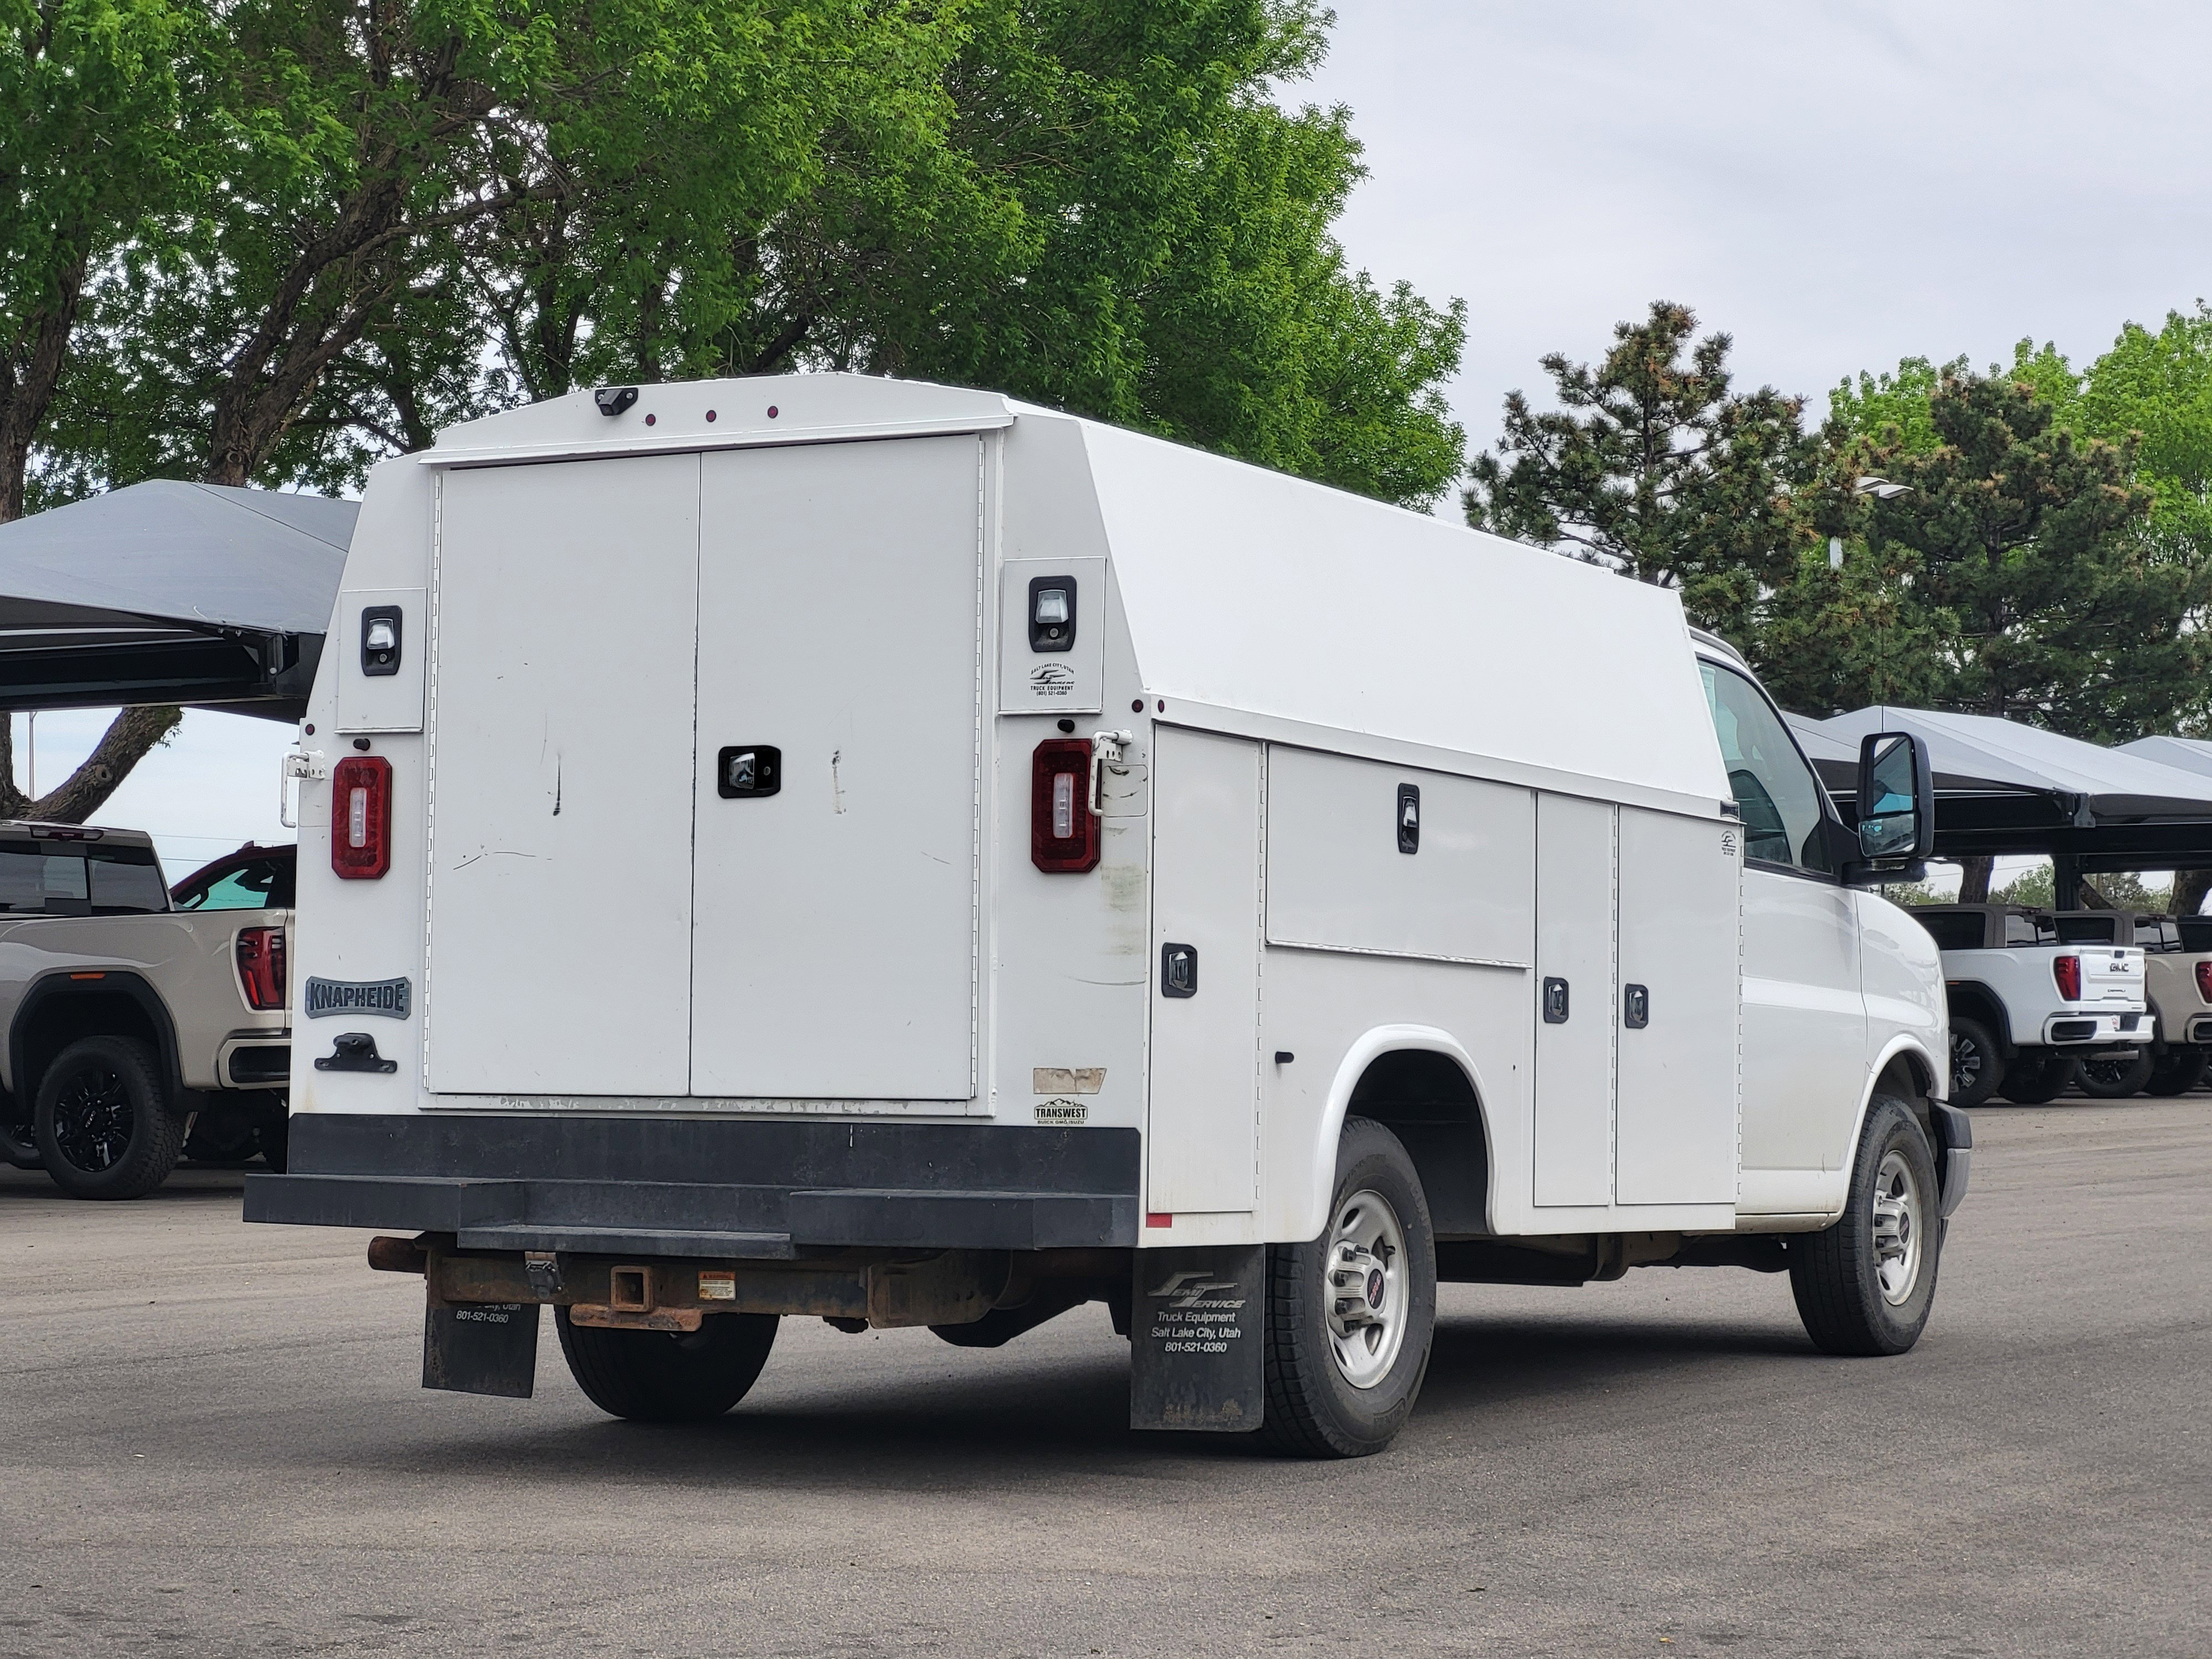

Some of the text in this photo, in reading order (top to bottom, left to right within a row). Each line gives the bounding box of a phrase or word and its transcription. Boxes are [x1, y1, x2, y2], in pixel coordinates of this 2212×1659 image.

[1031, 666, 1041, 675] SALT
[1063, 665, 1074, 675] UTAH
[2110, 963, 2129, 972] GMC
[310, 983, 404, 1012] KNAPHEIDE
[1036, 1108, 1086, 1118] TRANSWEST
[456, 1311, 509, 1323] 801-521-0360
[1157, 1312, 1235, 1324] Truck Equipment
[1151, 1327, 1241, 1340] Salt Lake City, Utah
[1165, 1342, 1227, 1352] 801-521-0360
